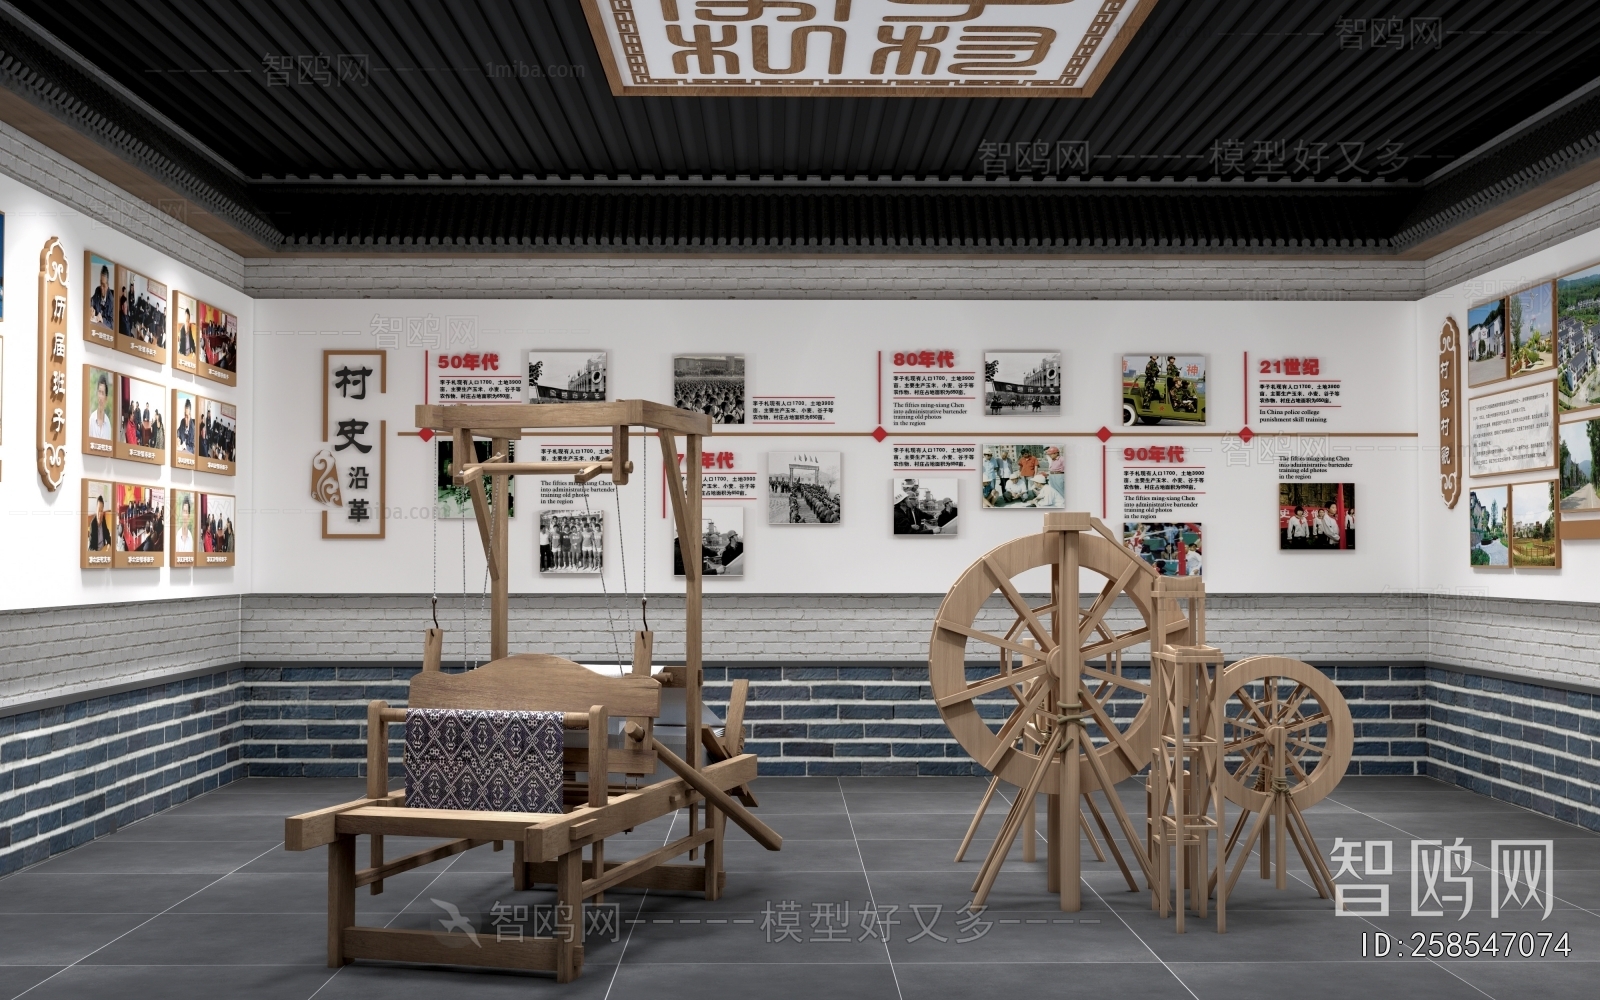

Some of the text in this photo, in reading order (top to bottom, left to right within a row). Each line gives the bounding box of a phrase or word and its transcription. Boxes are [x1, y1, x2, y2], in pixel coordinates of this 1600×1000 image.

[53, 295, 67, 433] 历届班子
[438, 354, 499, 371] 50年代
[893, 351, 955, 369] 80年代
[1259, 359, 1320, 376] 21世纪
[676, 452, 734, 469] 7年代
[1123, 446, 1185, 463] 90年代
